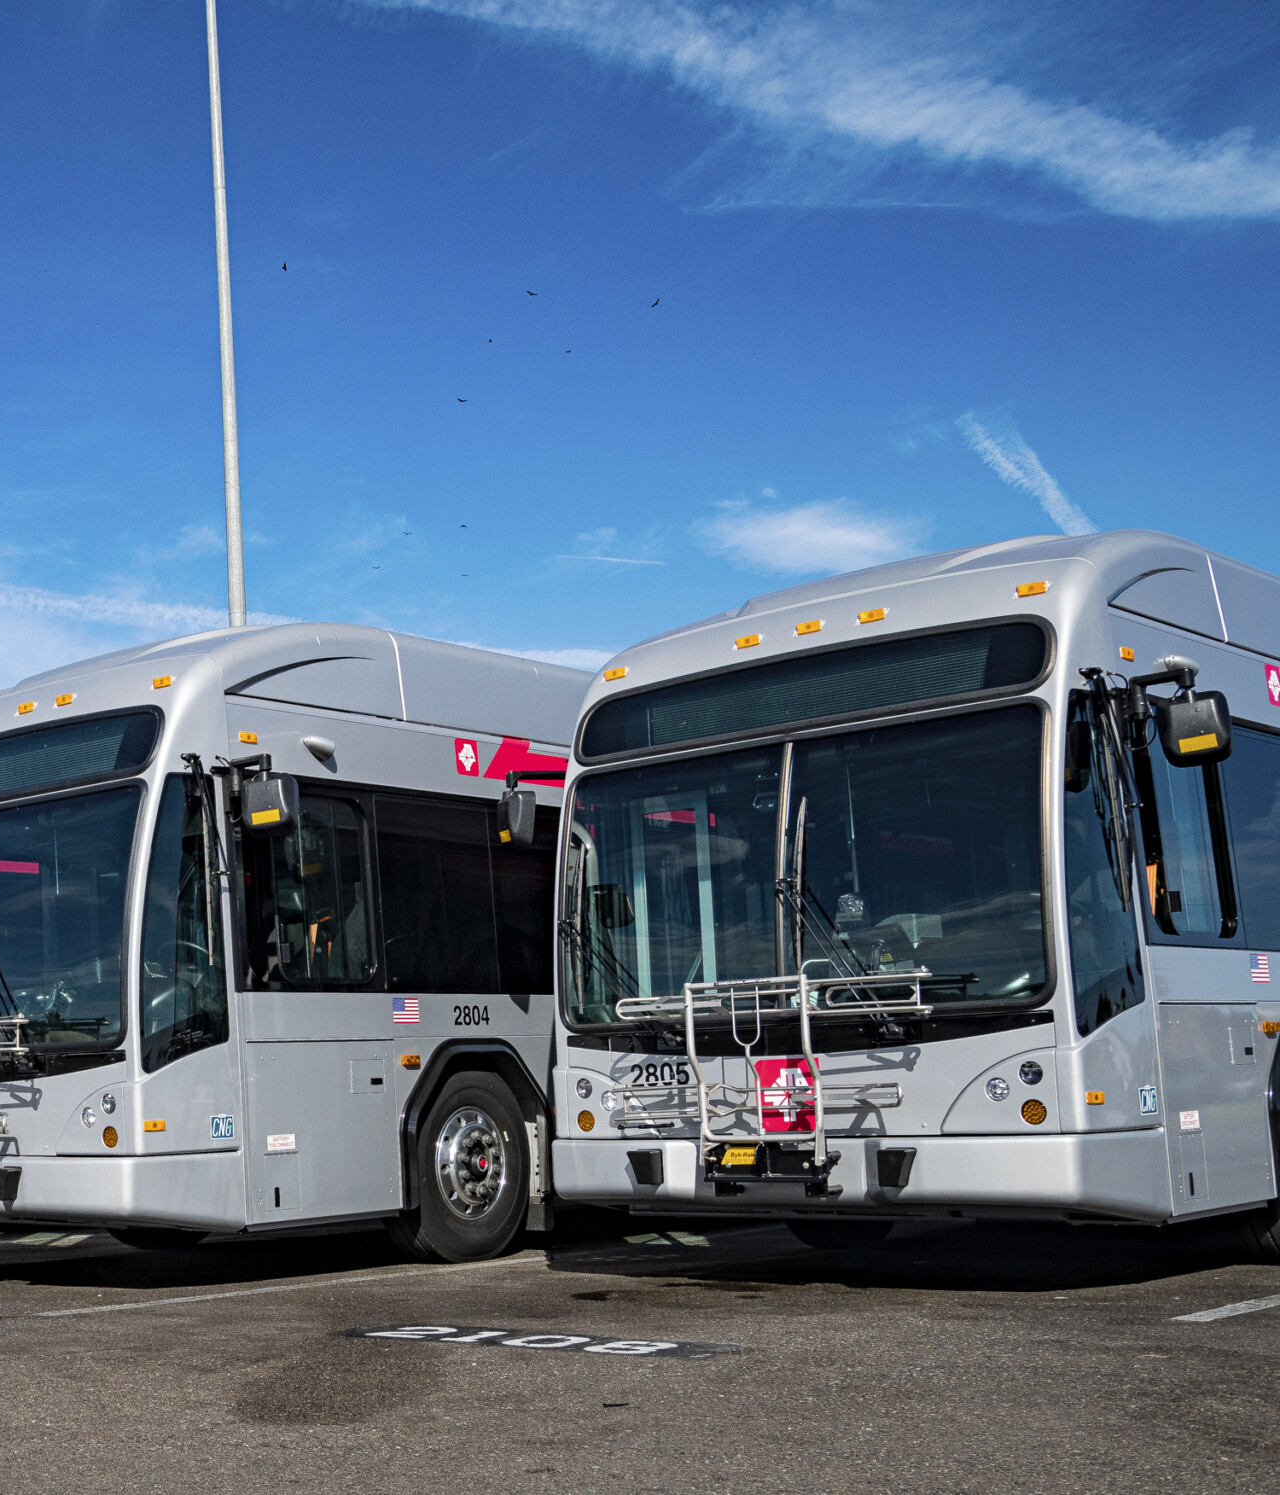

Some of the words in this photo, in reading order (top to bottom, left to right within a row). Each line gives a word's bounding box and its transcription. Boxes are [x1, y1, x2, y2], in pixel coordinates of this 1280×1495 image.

[453, 1005, 490, 1026] 2804
[630, 1061, 690, 1087] 2805
[1141, 1089, 1157, 1113] CNG
[212, 1117, 233, 1137] CNG
[364, 1326, 679, 1355] 2108
